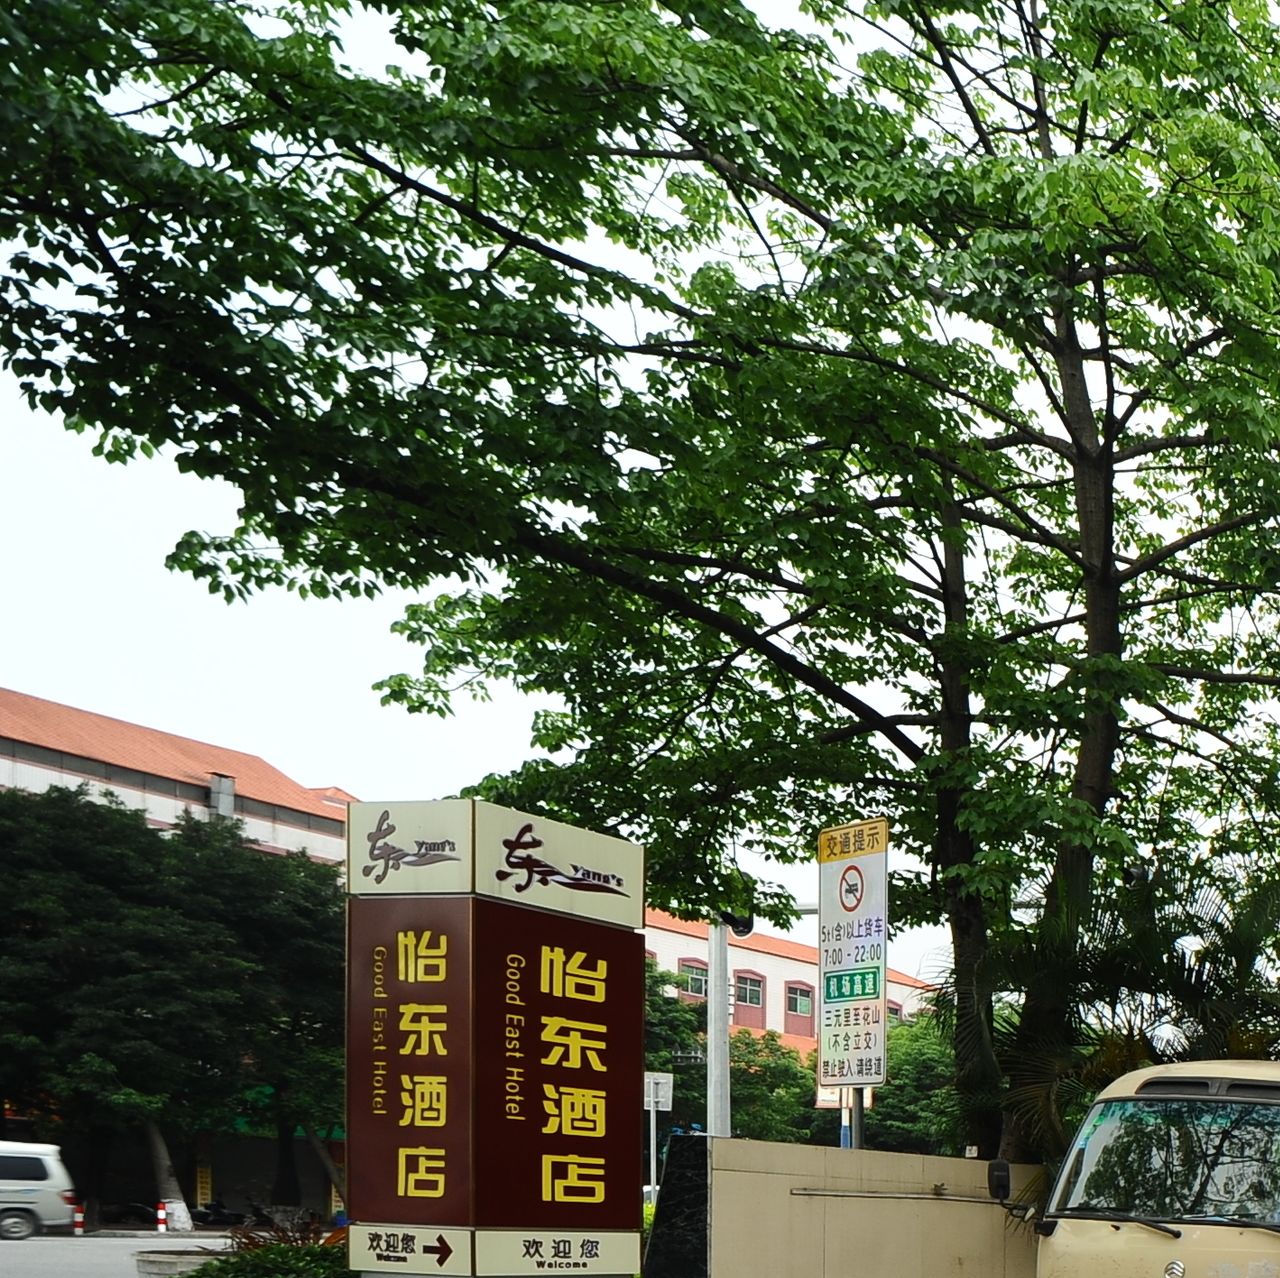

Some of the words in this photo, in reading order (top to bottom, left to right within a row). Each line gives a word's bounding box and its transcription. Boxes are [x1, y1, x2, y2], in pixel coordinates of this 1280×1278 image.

[826, 826, 880, 858] 交通提示
[373, 946, 387, 999] Good
[824, 948, 843, 967] 7:00
[854, 943, 882, 963] 22:00
[505, 953, 525, 1005] Good
[829, 973, 876, 998] 机场高速
[373, 1007, 387, 1052] East
[505, 1013, 525, 1061] East
[824, 1005, 880, 1028] 三元里至花山
[397, 930, 448, 1198] 怡东酒店
[540, 945, 607, 1203] 怡东酒店
[373, 1061, 387, 1115] Hotel
[505, 1067, 525, 1121] Hotel
[367, 1231, 416, 1254] 欢迎您
[522, 1238, 600, 1259] 欢迎您
[536, 1260, 588, 1269] Welcome
